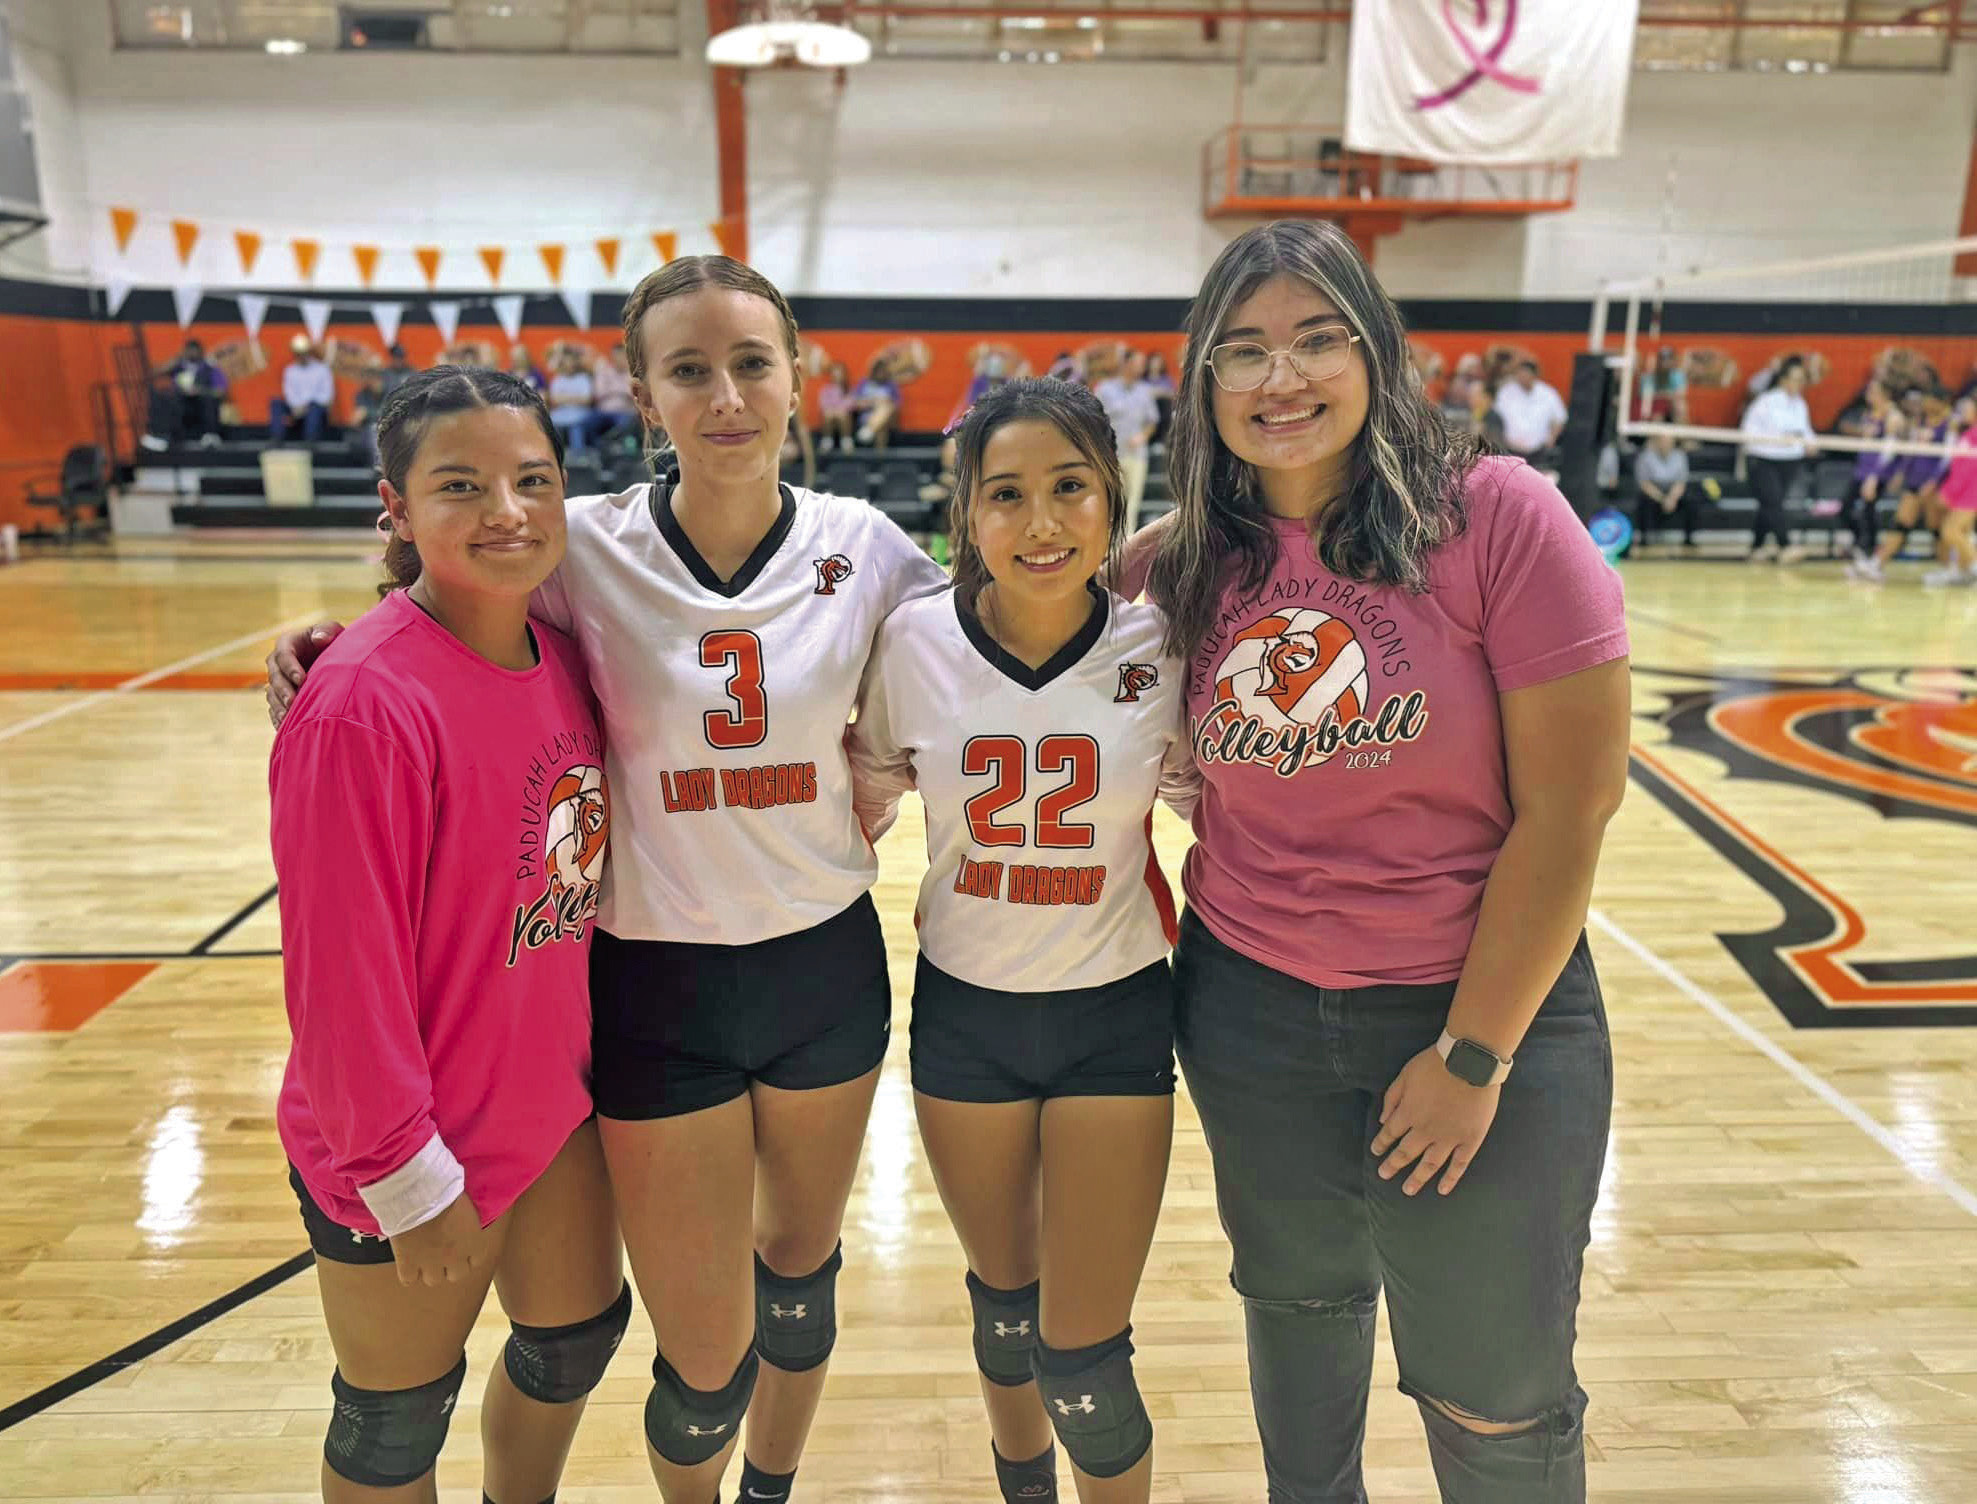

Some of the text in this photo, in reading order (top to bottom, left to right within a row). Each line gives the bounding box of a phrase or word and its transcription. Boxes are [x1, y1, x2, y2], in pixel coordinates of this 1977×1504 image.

[1193, 578, 1411, 695] PADUCAH LADY DRAGONS
[699, 629, 767, 749] 3
[1192, 690, 1429, 778] Volleyball
[516, 760, 548, 880] PADUCAH
[541, 731, 578, 765] LADY
[660, 762, 817, 813] LADY DRAGONS
[962, 734, 1100, 848] 22
[1345, 749, 1393, 769] 2024
[954, 854, 1106, 905] LADY DRAGONS
